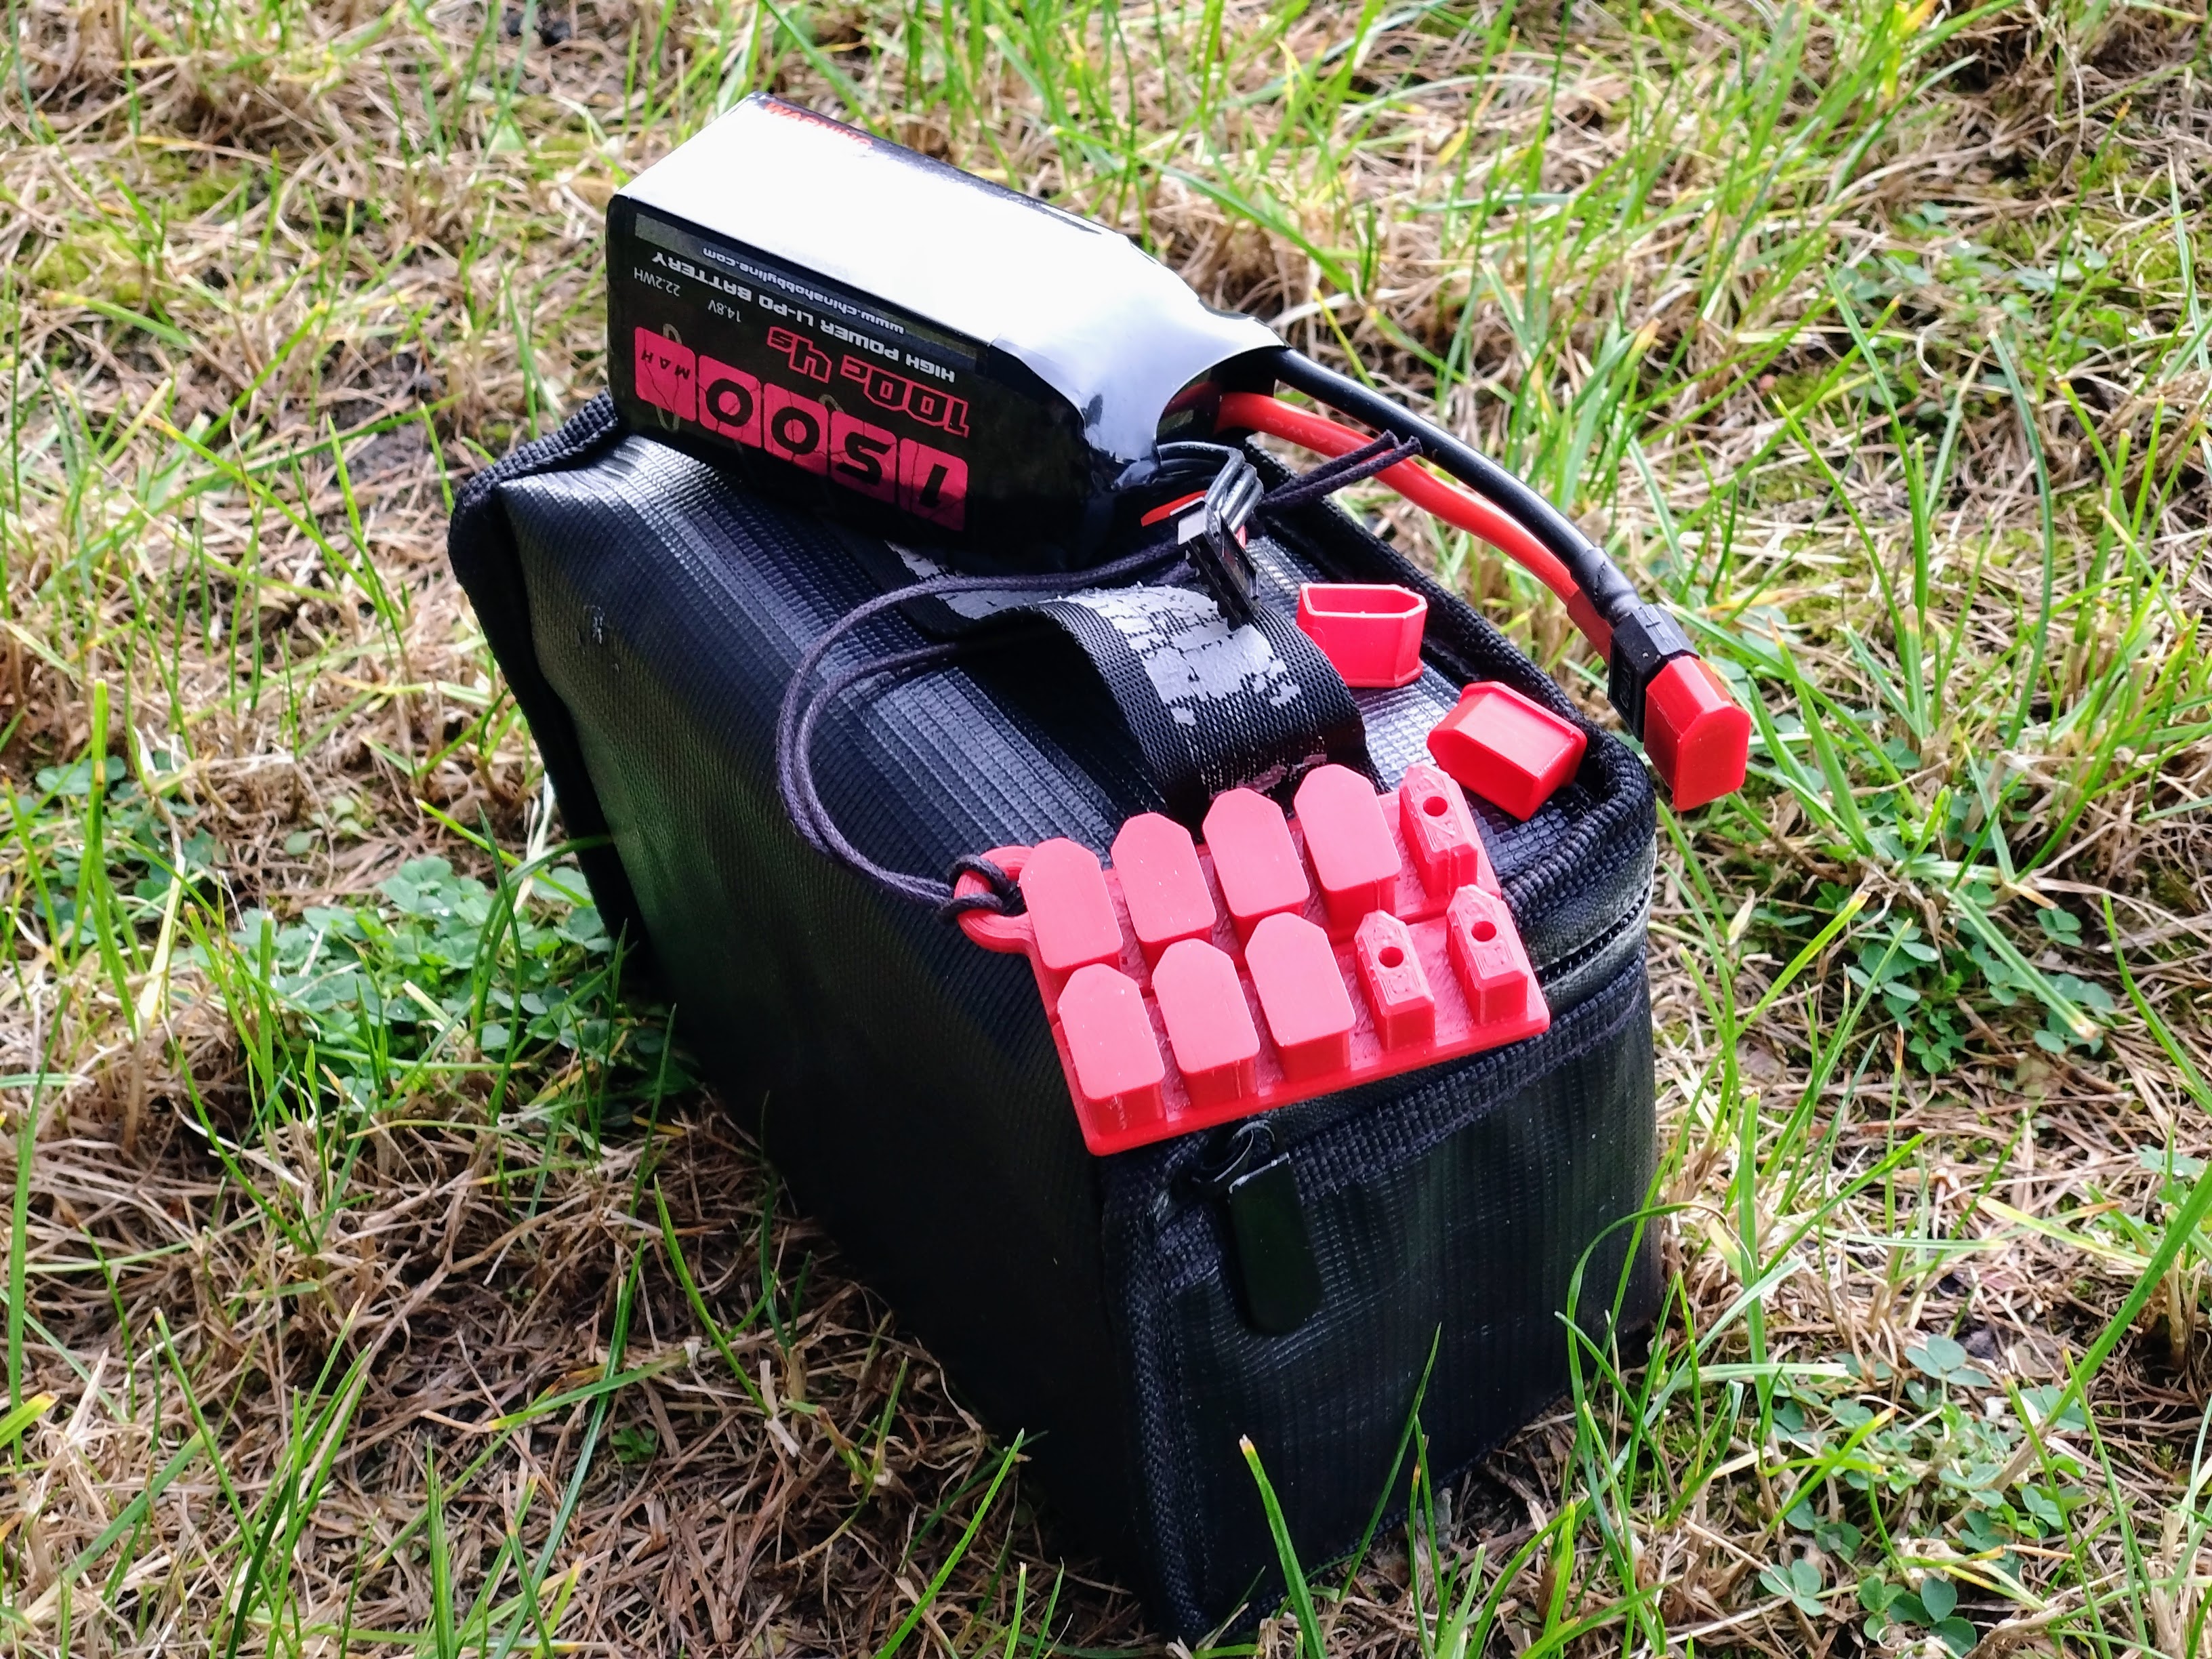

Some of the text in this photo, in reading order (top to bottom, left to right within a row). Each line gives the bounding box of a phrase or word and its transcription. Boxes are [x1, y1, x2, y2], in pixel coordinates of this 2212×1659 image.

[634, 266, 680, 297] 22.2WH
[652, 251, 752, 302] BATTERY
[702, 247, 905, 335] www.chinahobbyline.com
[708, 299, 742, 323] 14.8V
[820, 319, 899, 362] POWER
[905, 354, 956, 384] HIGH
[705, 377, 950, 508] 1500
